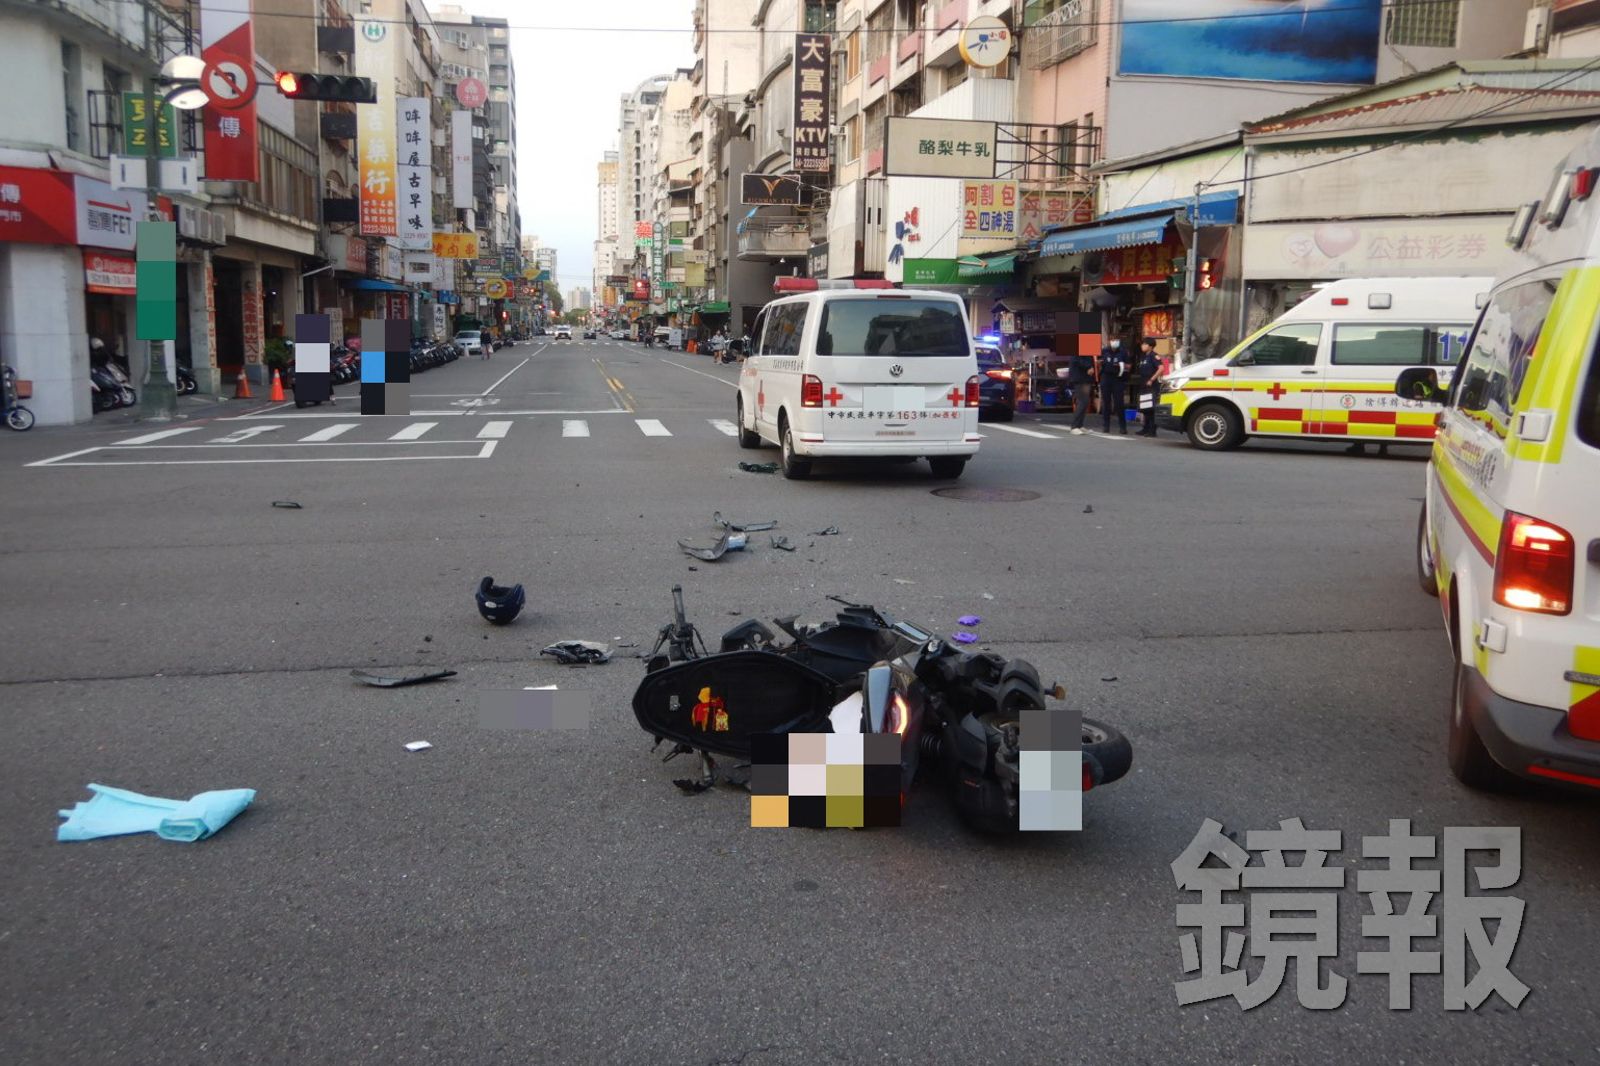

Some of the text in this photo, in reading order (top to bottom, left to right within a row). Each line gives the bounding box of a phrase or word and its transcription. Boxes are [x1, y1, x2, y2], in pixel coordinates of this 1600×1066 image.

[800, 37, 825, 122] 大富豪
[795, 127, 827, 143] KTV
[919, 139, 990, 158] 酪梨牛乳
[405, 109, 424, 230] 哞哞屋古早味
[980, 210, 1014, 232] 四神湯
[1367, 233, 1487, 261] 公益彩券
